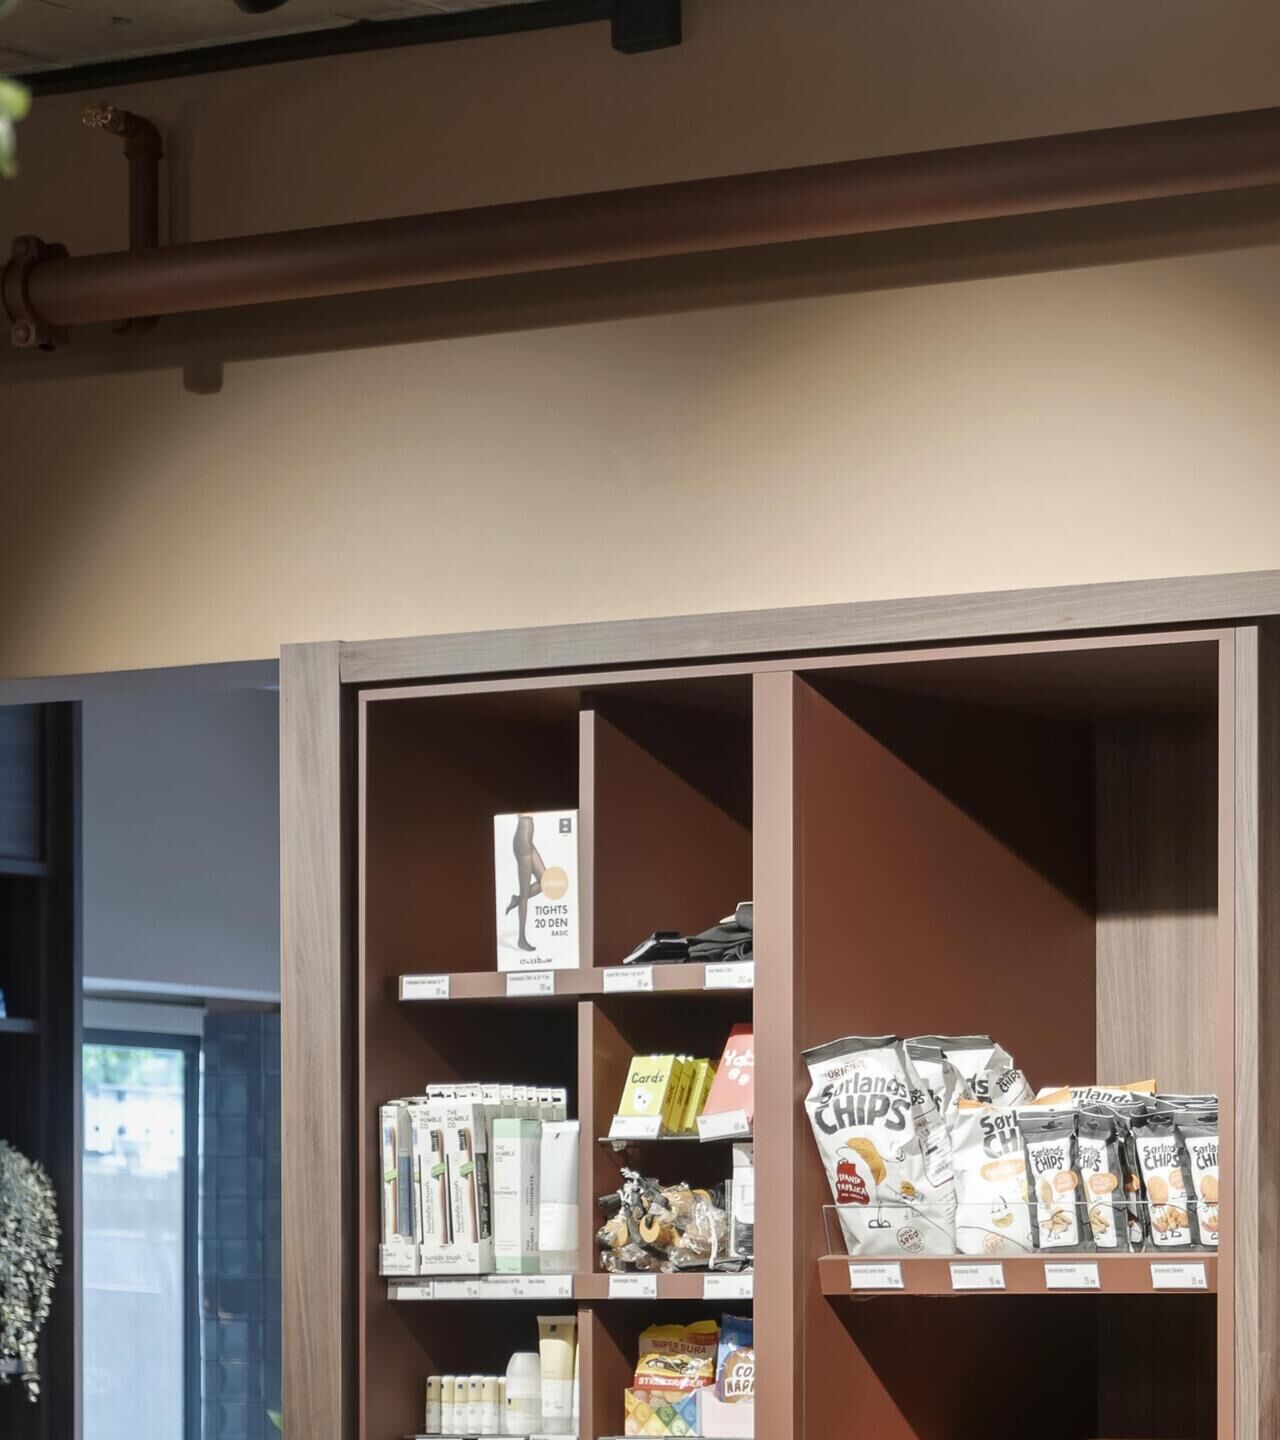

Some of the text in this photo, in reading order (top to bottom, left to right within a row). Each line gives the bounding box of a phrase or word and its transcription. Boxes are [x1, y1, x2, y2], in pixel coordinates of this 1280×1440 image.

[535, 905, 568, 916] TIGHTS
[534, 918, 568, 929] 20 DEN
[631, 1069, 664, 1084] Cards
[1000, 1069, 1021, 1093] CHIPS
[814, 1094, 911, 1135] CHIPS
[1031, 1145, 1064, 1159] Sørlands
[1035, 1155, 1065, 1174] CHIPS
[1144, 1154, 1180, 1171] CHIPS
[836, 1181, 867, 1197] PAPRIKA
